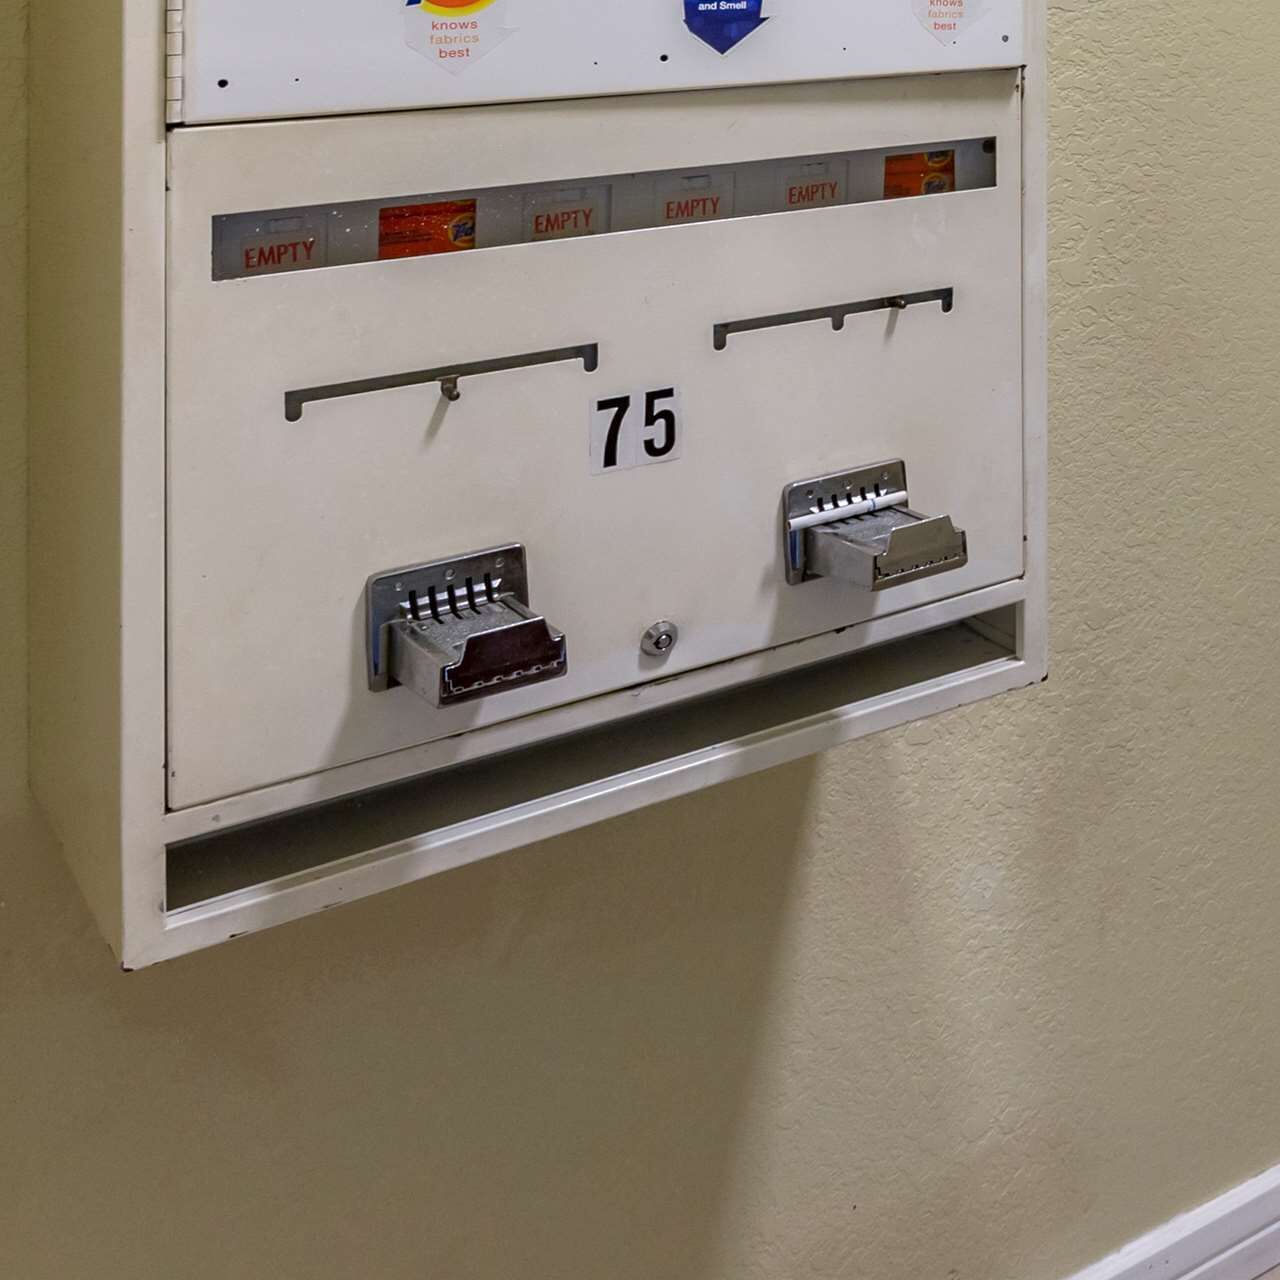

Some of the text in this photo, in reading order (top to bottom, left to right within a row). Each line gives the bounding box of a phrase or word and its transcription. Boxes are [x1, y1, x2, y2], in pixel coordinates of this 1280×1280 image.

[698, 1, 747, 10] and Smell
[928, 10, 964, 19] fabrics
[431, 20, 478, 30] knows
[933, 22, 957, 31] best
[430, 33, 480, 45] fabrics
[438, 48, 470, 59] best
[787, 181, 838, 205] EMPTY
[665, 196, 721, 219] EMPTY
[533, 208, 594, 235] EMPTY
[244, 240, 316, 269] EMPTY
[596, 387, 677, 469] 75
